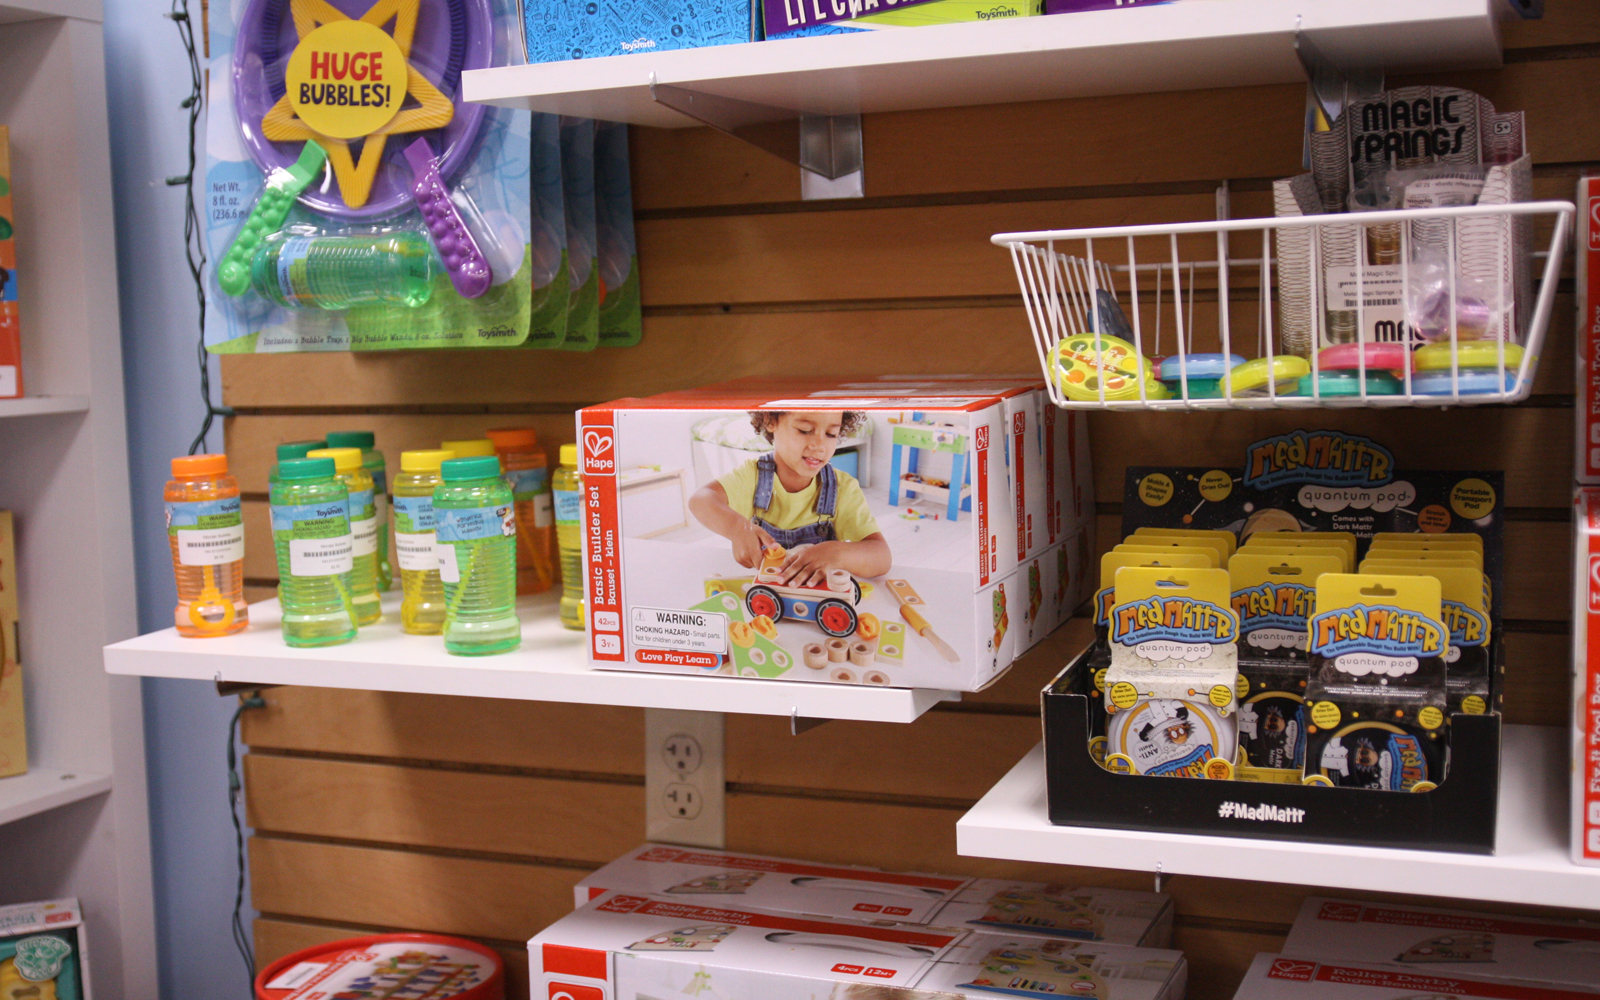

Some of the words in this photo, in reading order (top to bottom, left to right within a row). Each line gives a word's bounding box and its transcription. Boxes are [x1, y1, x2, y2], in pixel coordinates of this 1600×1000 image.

[784, 0, 827, 26] LIL
[976, 6, 1018, 20] Toysmith
[621, 38, 655, 51] Toysmith
[310, 51, 382, 81] HUGE
[299, 83, 390, 107] BUBBLES!
[1362, 94, 1459, 132] MAGIC
[1496, 123, 1509, 133] 5+
[1351, 125, 1466, 163] SPRINGS
[212, 182, 226, 192] Net
[228, 181, 241, 192] Wt.
[212, 196, 218, 206] 8
[212, 209, 237, 220] (236.6
[1375, 289, 1395, 297] Springs
[477, 326, 517, 339] Toysmith
[565, 331, 587, 343] smith
[586, 457, 613, 471] Hape
[589, 485, 600, 507] Set
[1303, 491, 1371, 503] quantum
[1377, 490, 1406, 504] pod
[1453, 494, 1492, 503] Transport
[1456, 488, 1490, 496] Portable
[316, 507, 343, 517] Toysmith
[590, 512, 602, 562] Builder
[605, 529, 614, 558] klein
[594, 567, 604, 605] Basic
[606, 568, 617, 605] Bauset
[656, 612, 707, 627] WARNING:
[635, 625, 664, 634] CHOKING
[664, 628, 690, 637] HAZARD
[1136, 631, 1164, 640] Unbelievable
[1250, 633, 1295, 641] quantum
[1298, 634, 1309, 642] po
[601, 639, 615, 648] 3Y+
[1139, 644, 1183, 653] quantum
[1186, 644, 1206, 653] pod
[1335, 642, 1366, 652] Unbelievable
[642, 652, 663, 662] Love
[664, 654, 684, 665] Play
[685, 654, 712, 664] Learn
[1339, 658, 1387, 667] quantum
[1391, 659, 1411, 668] pod
[1218, 800, 1305, 823] #MadMattr
[652, 903, 696, 913] Roller
[703, 909, 752, 920] Derby
[1377, 911, 1429, 920] Roller
[1436, 915, 1494, 927] Derby
[1270, 970, 1309, 979] Hape
[1333, 968, 1389, 980] Roller
[1397, 974, 1460, 988] Derby
[1330, 976, 1466, 994] Kugel-Rennbahn
